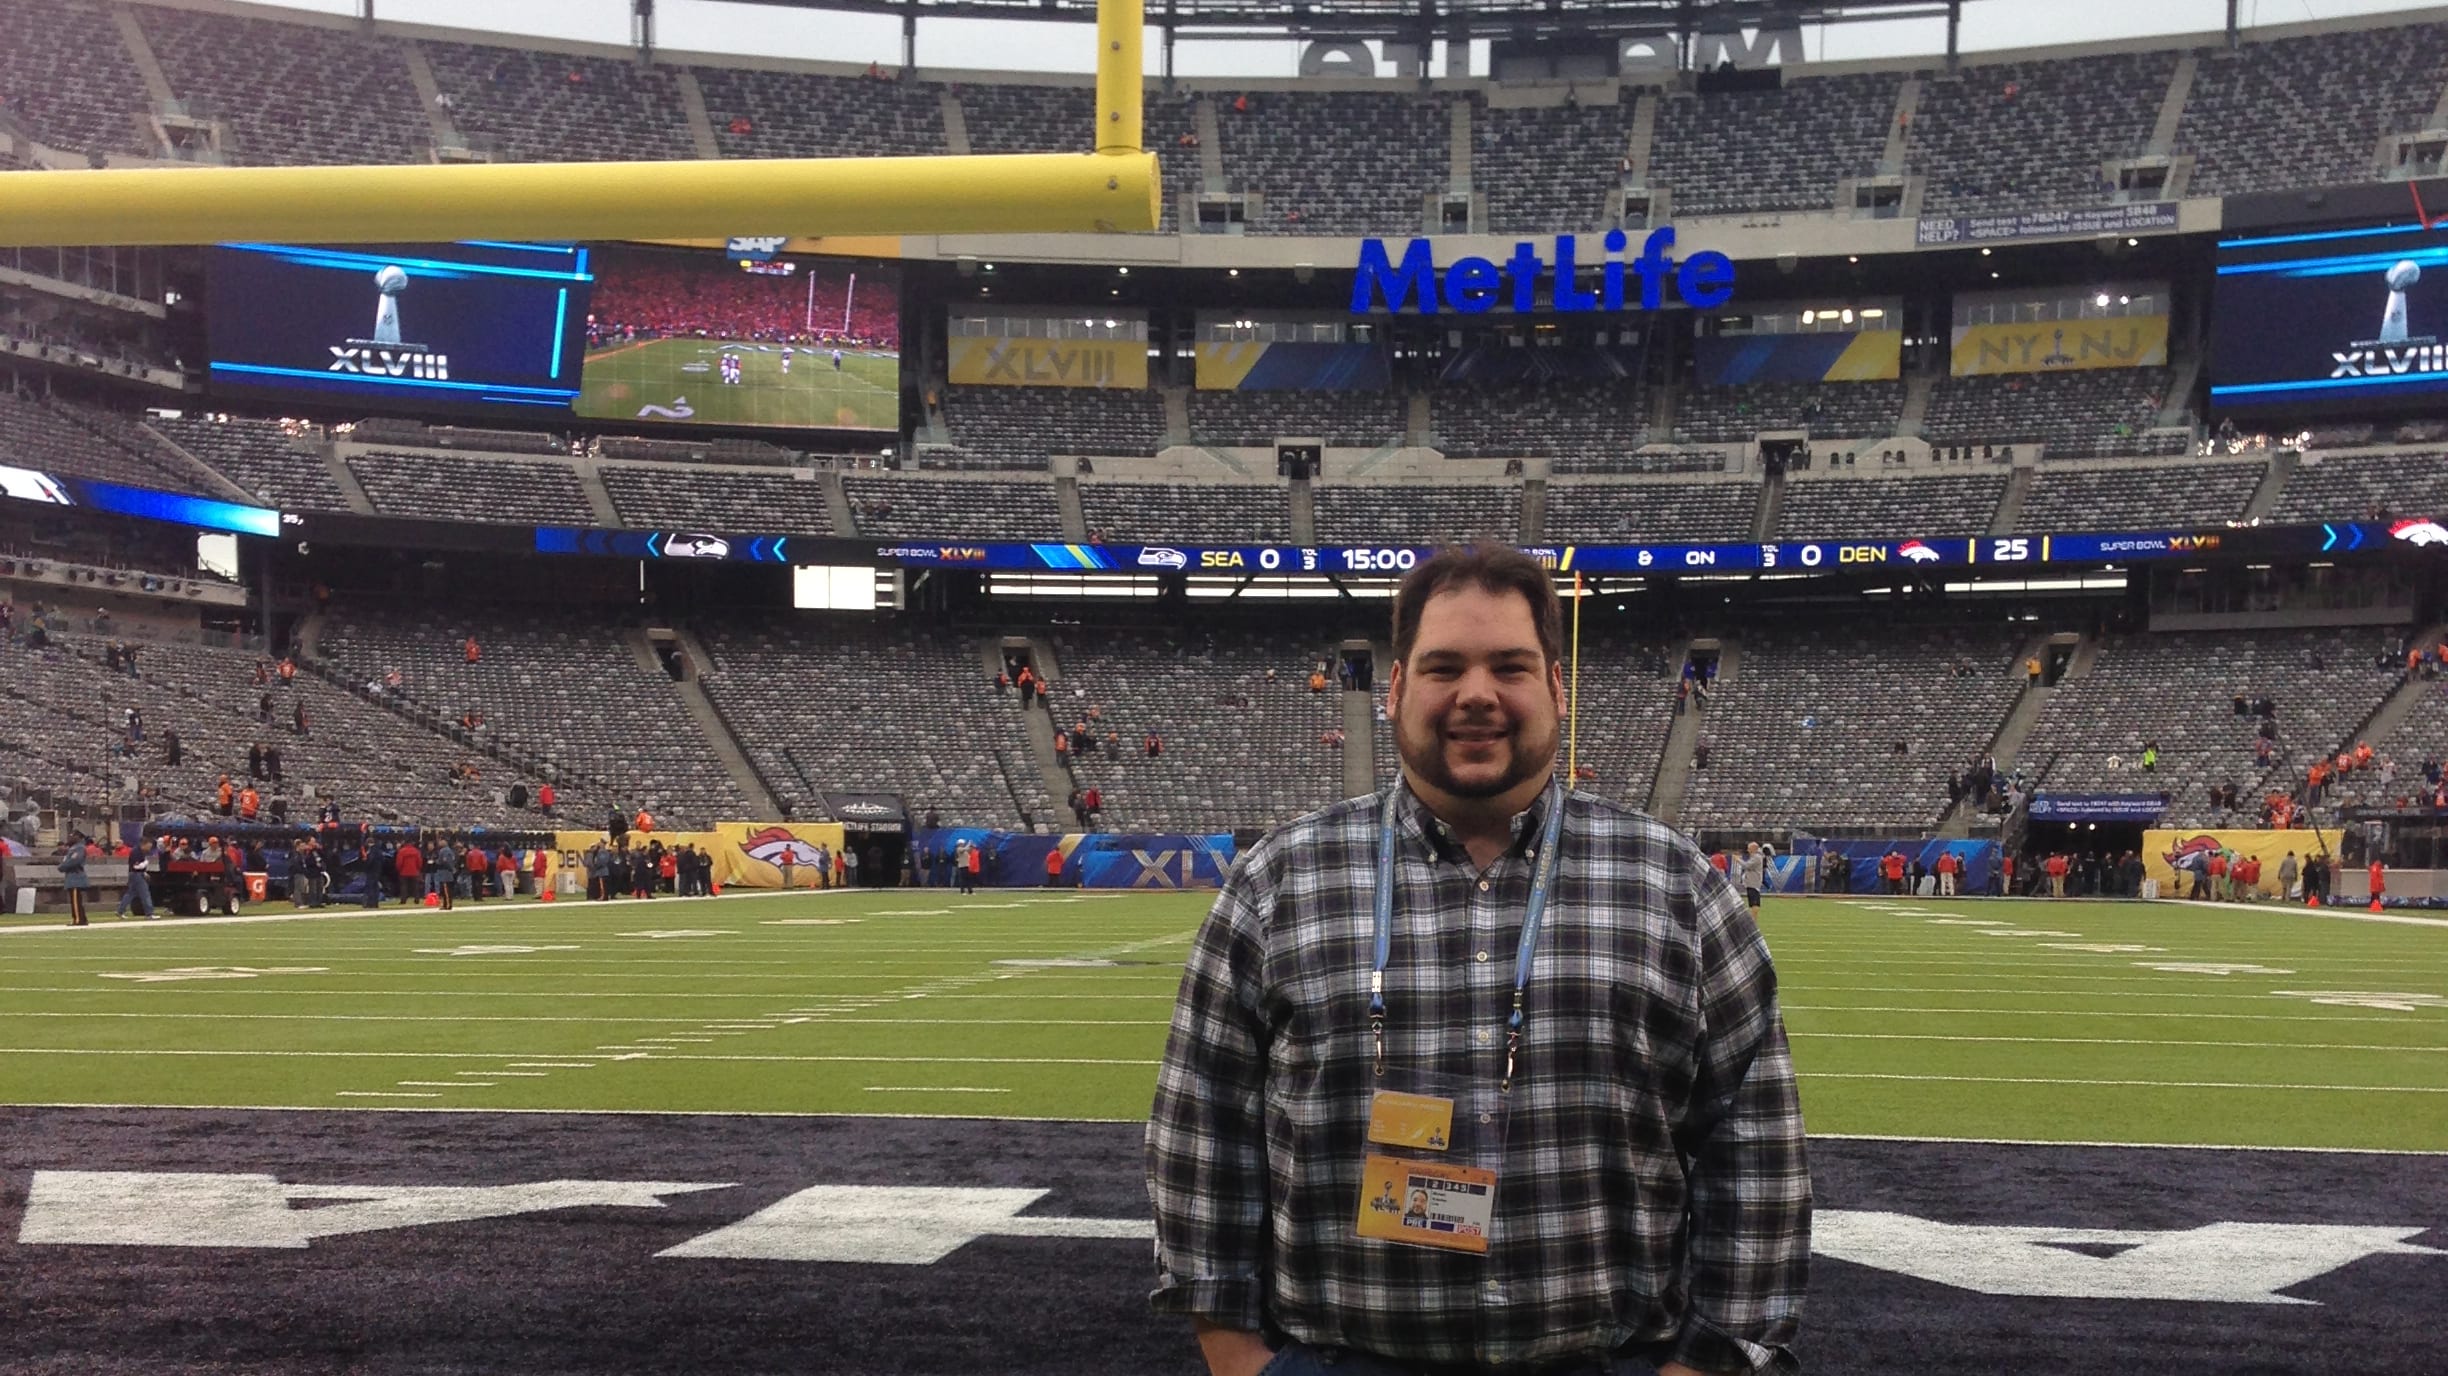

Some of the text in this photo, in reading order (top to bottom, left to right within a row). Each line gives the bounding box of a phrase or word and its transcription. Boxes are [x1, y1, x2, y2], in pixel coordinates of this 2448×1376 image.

[1919, 219, 1955, 231] NEED
[2126, 214, 2175, 227] LOCATION
[1919, 230, 1959, 243] HELP?
[1350, 227, 1737, 314] MetLife
[1979, 327, 2139, 366] NY NJ
[327, 346, 448, 380] XLVIII
[984, 346, 1116, 382] XLVIII
[1993, 540, 2028, 561] 25
[2101, 536, 2220, 552] SUPER BOWL XLVIII
[877, 547, 986, 560] SUPER BOWL XLVIII
[1200, 549, 1280, 569] SEA 0
[1342, 549, 1416, 570] 15:00
[1638, 550, 1716, 566] & ON
[1763, 553, 1776, 567] 3
[1801, 545, 1887, 566] 0 DEN
[1303, 556, 1316, 570] 3
